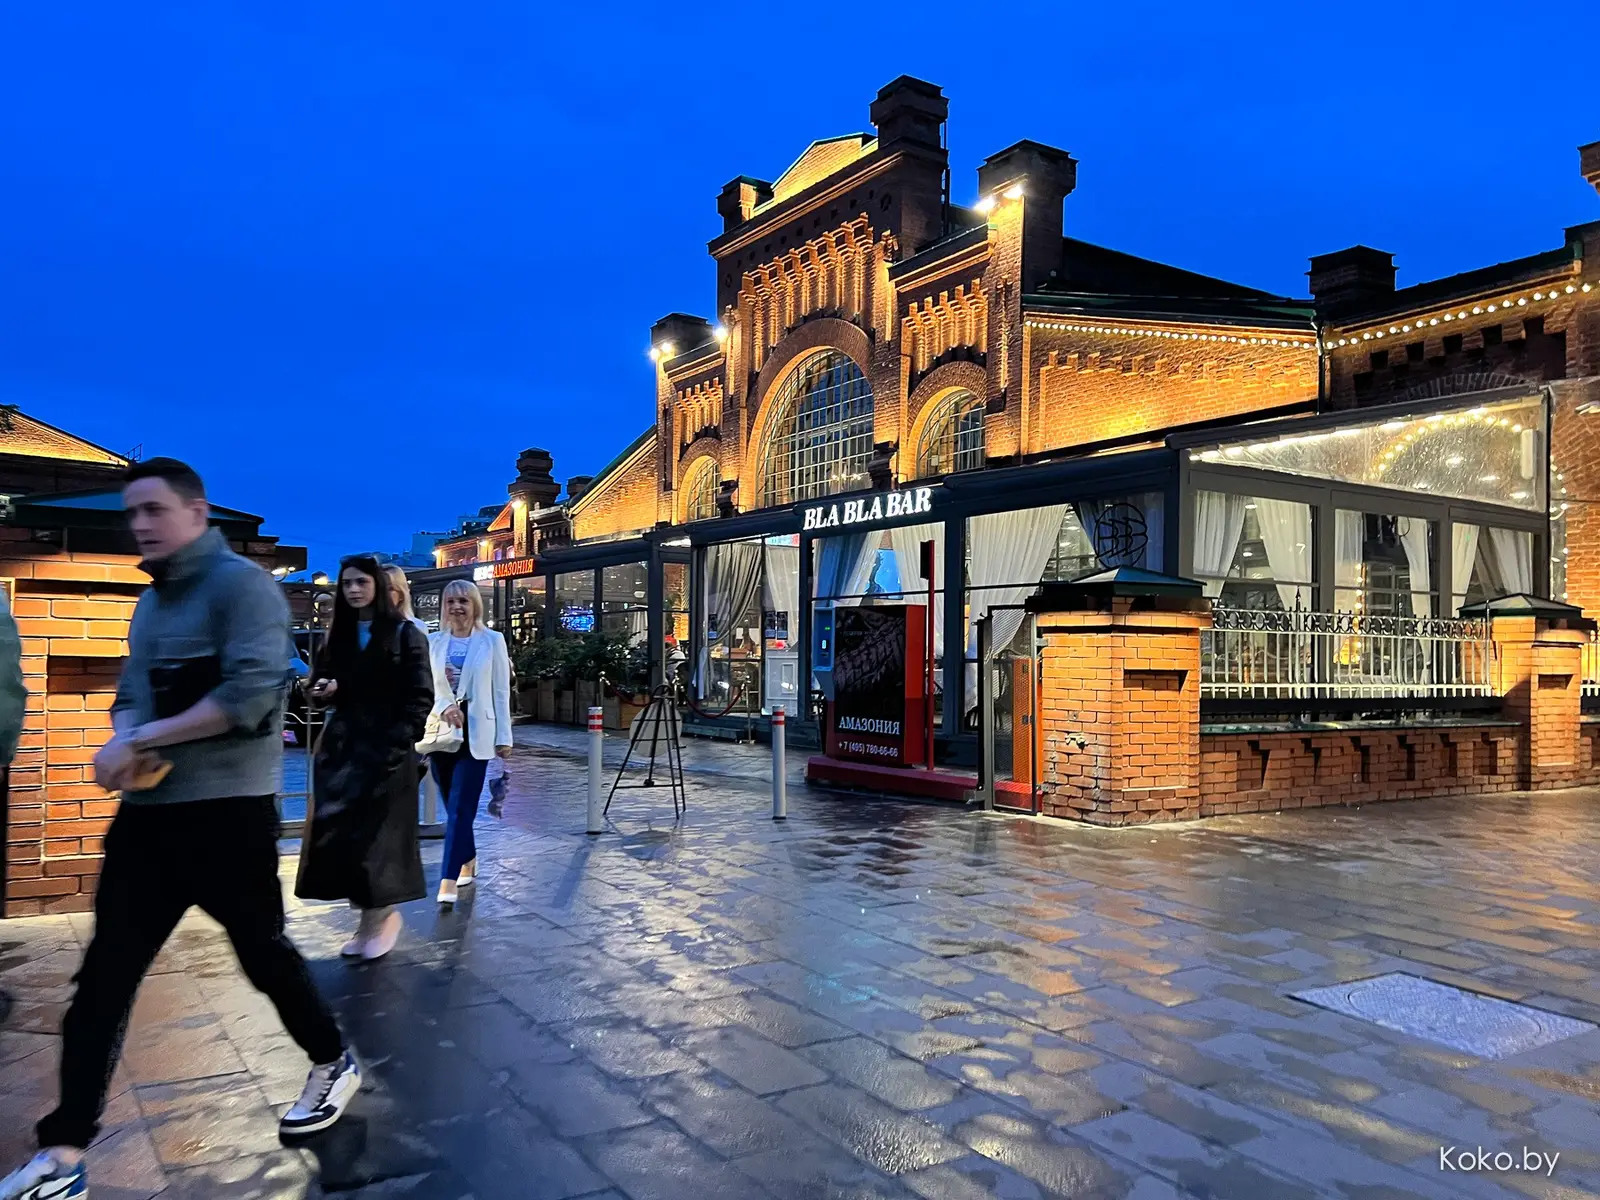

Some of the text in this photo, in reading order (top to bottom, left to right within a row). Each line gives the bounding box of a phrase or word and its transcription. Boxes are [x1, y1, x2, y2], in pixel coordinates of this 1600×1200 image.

[803, 487, 931, 530] BLA BLA BAR
[839, 716, 900, 735] АМАЗОНИЯ
[866, 744, 898, 757] 780-66-66
